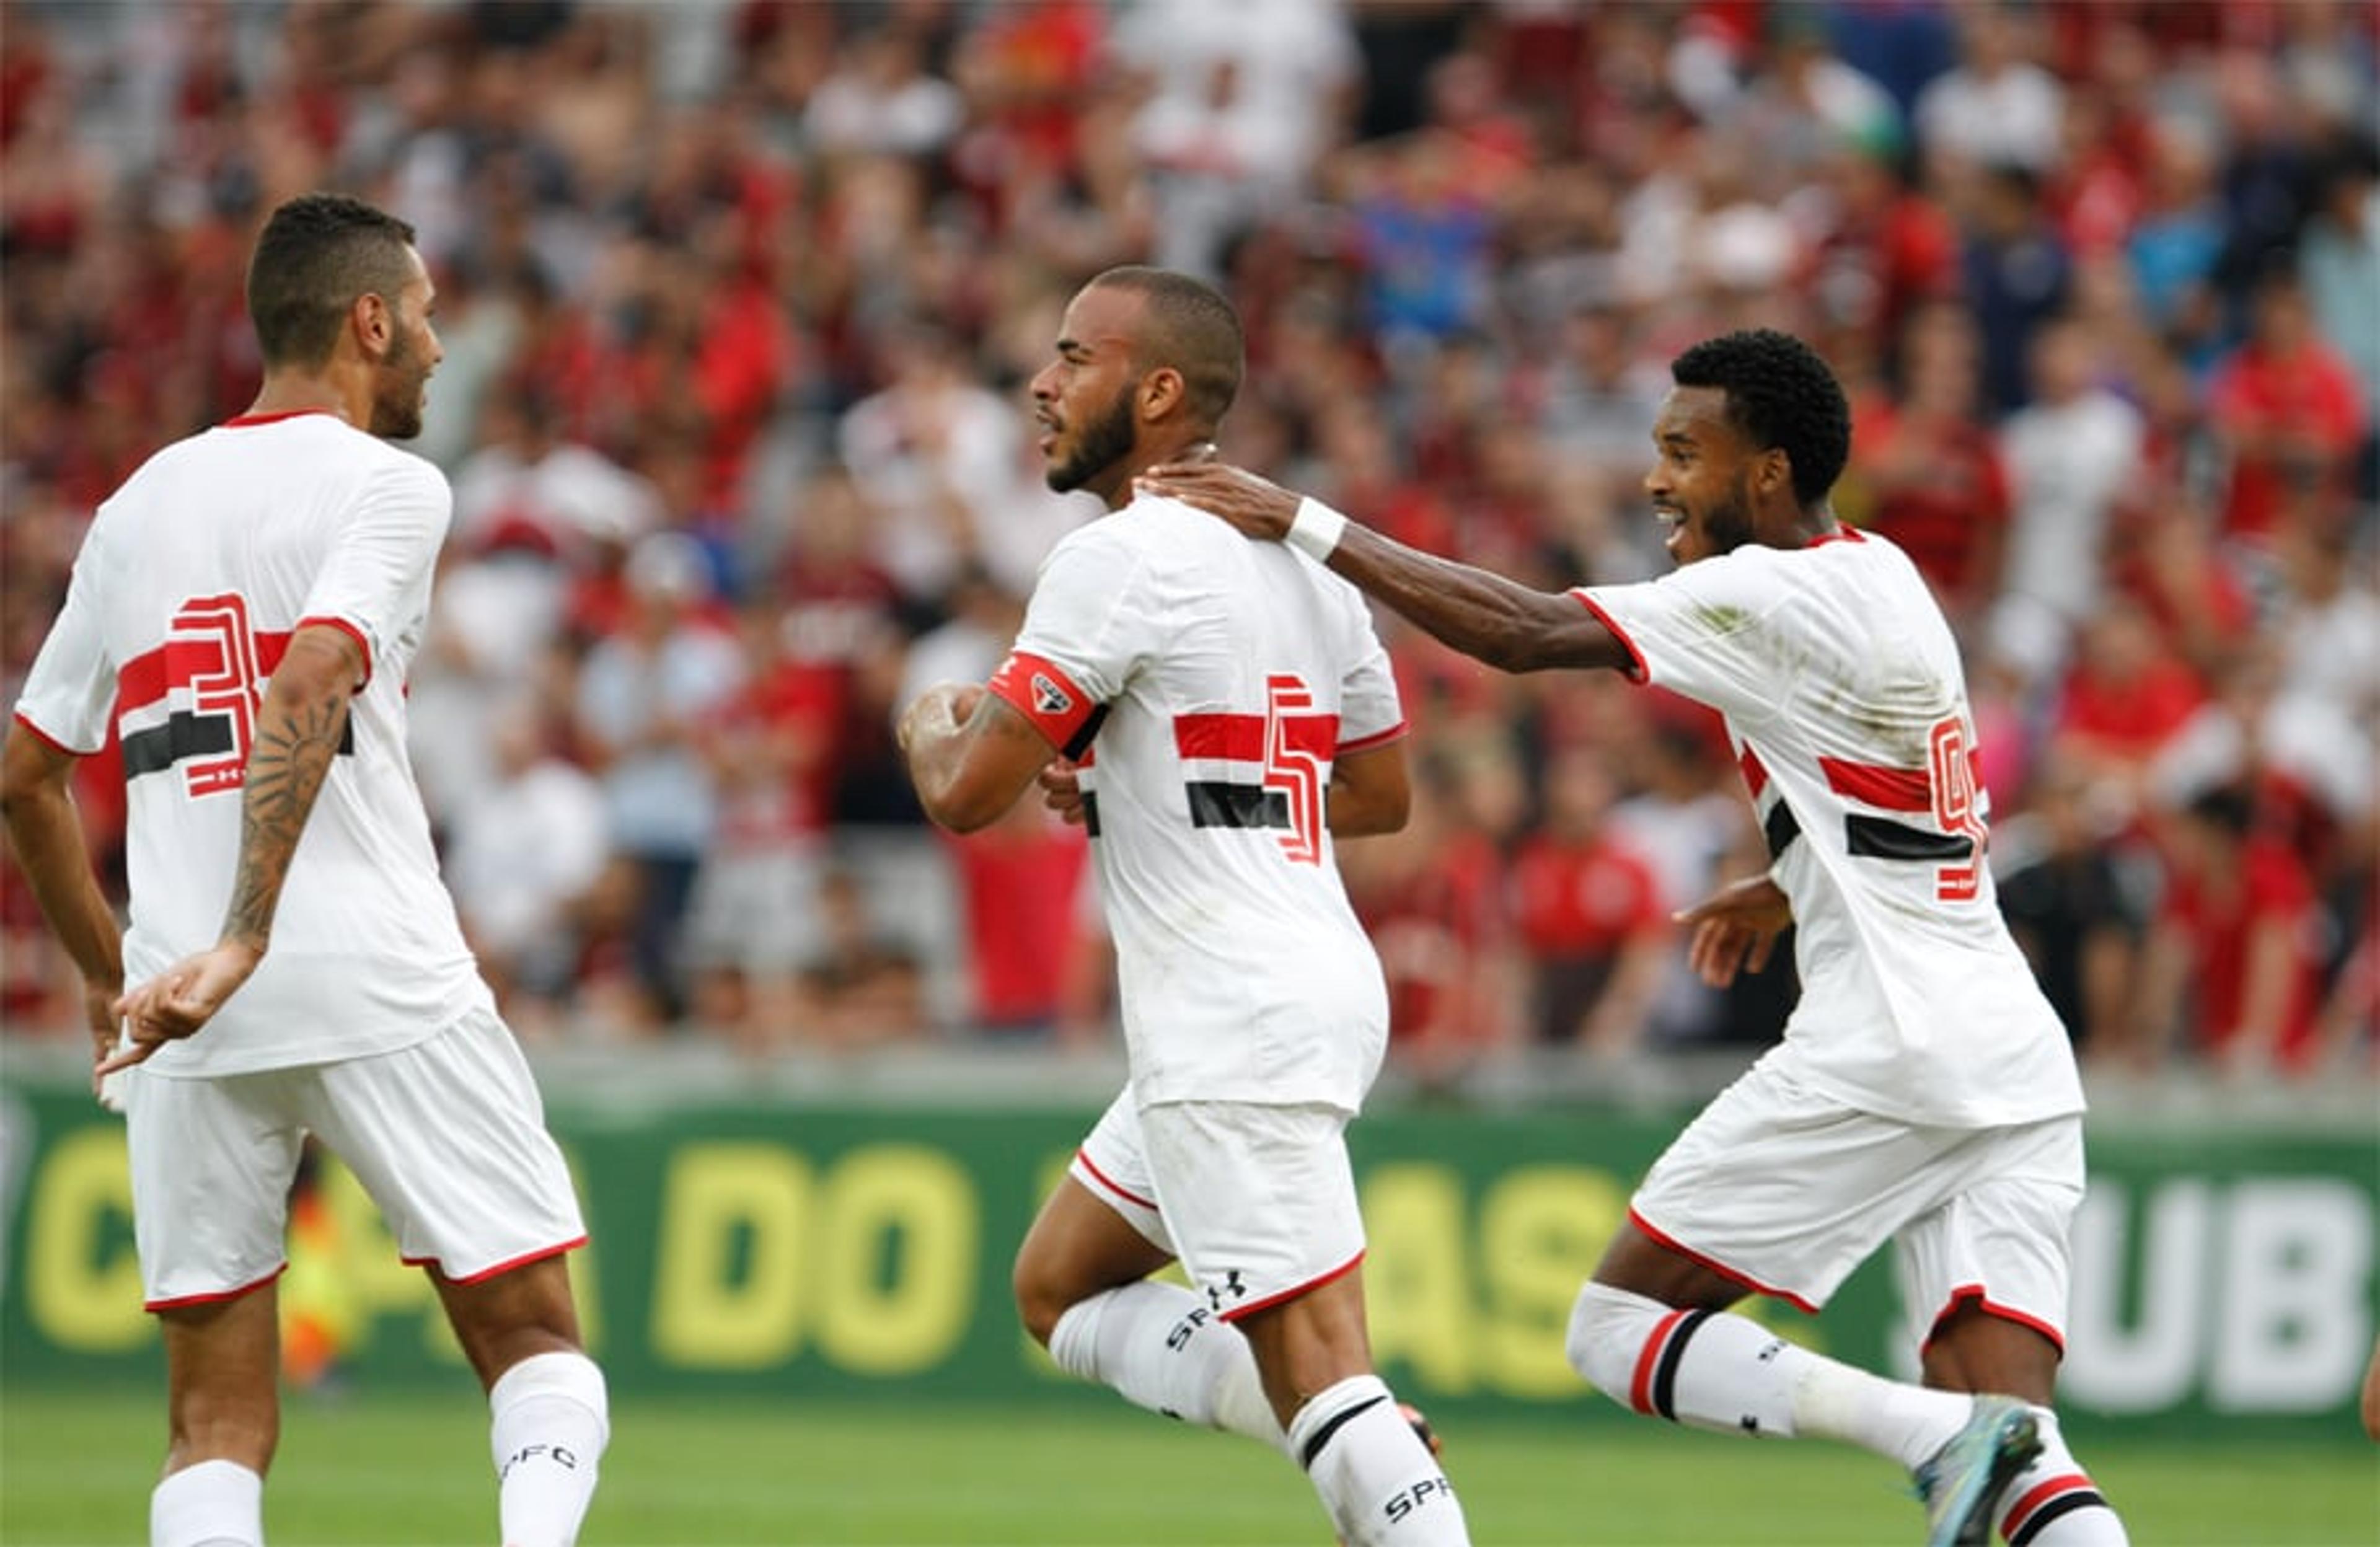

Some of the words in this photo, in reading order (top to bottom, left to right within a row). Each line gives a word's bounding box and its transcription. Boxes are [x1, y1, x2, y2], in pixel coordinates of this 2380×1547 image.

[172, 591, 262, 799] 3
[1263, 672, 1321, 868] 5
[1929, 715, 1989, 904] 9
[651, 1142, 981, 1372] DO
